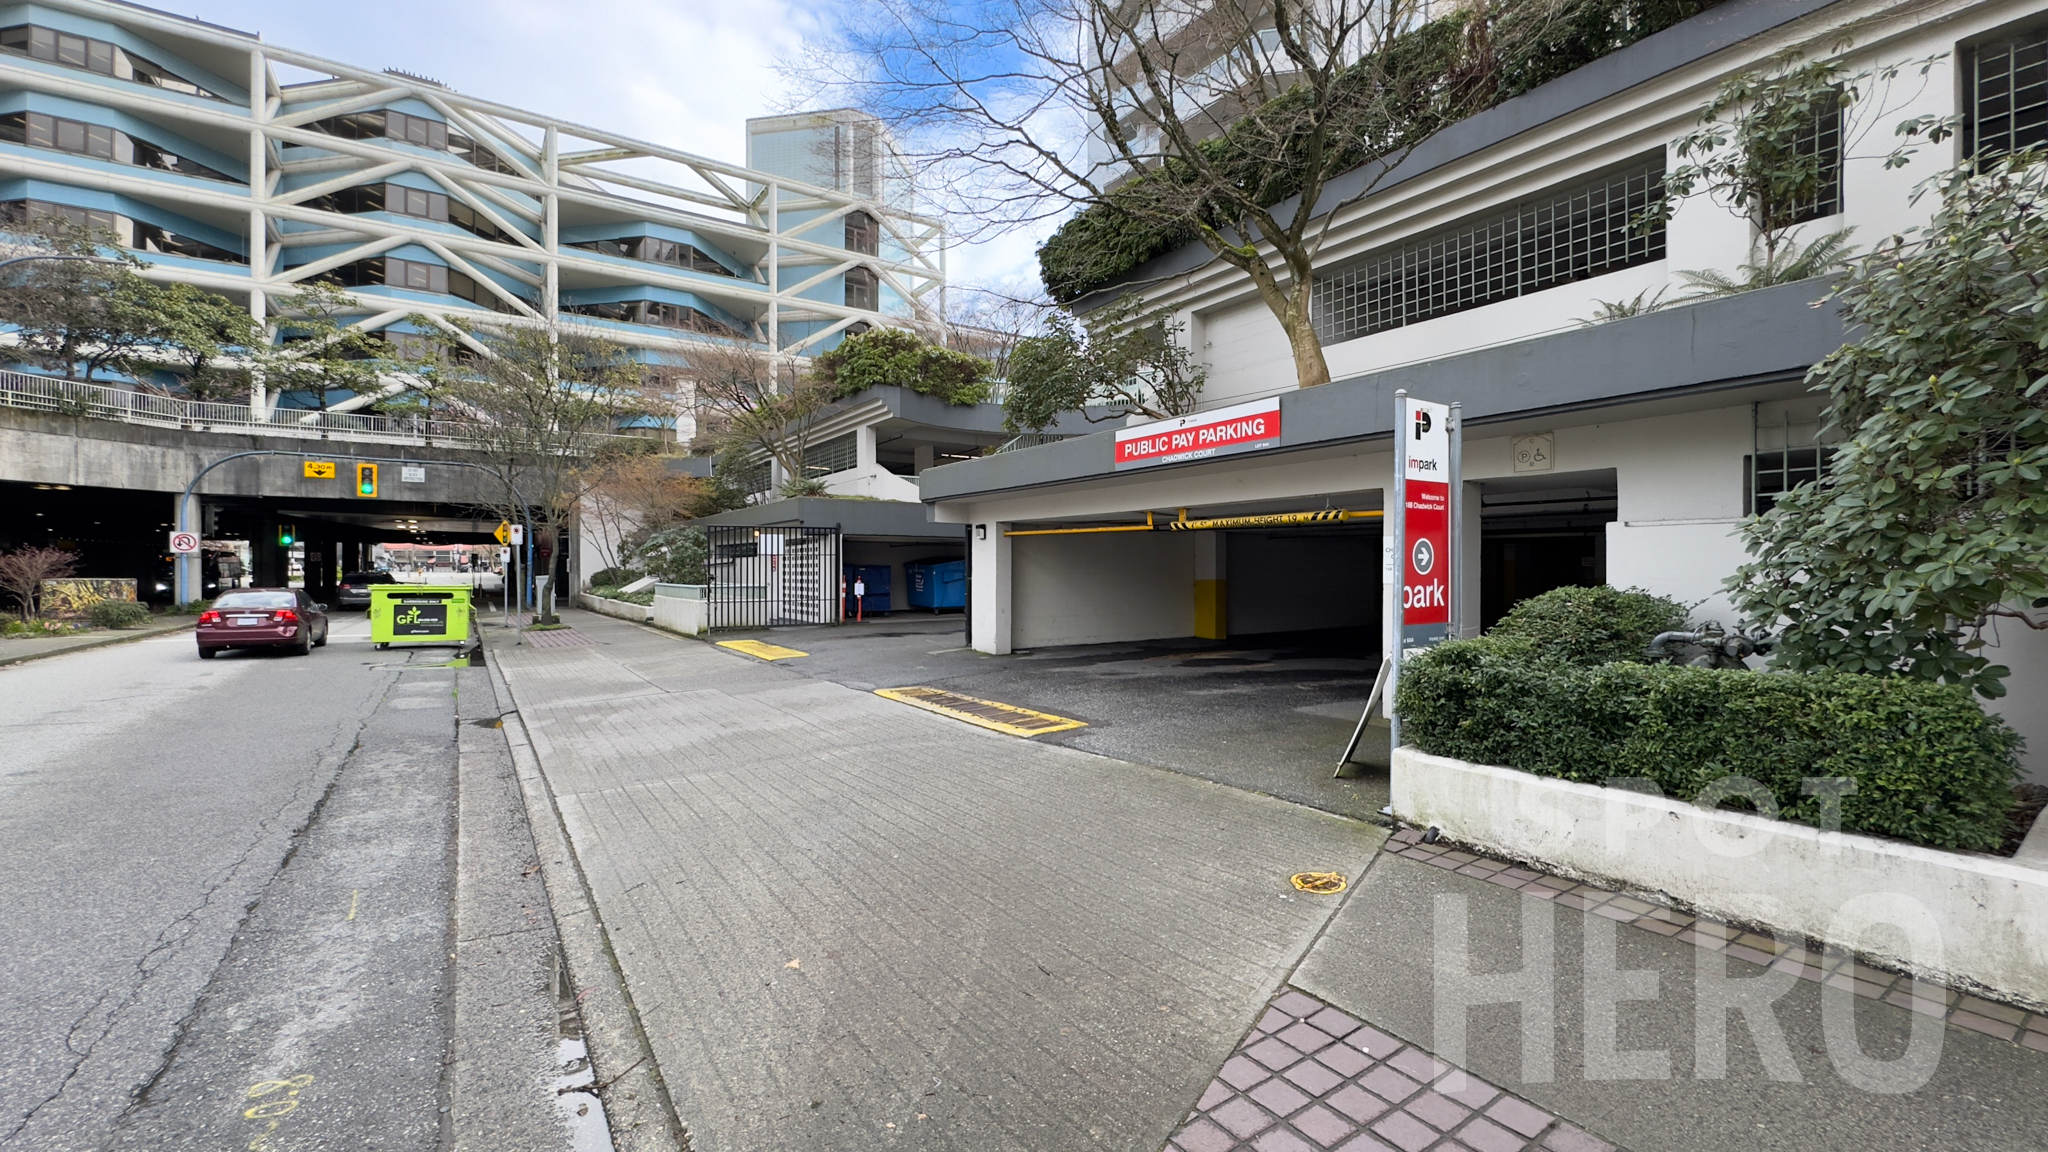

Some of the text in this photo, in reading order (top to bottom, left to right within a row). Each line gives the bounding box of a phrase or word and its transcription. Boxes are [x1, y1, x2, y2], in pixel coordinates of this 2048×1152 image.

[1124, 418, 1265, 457] PUBLIC PAY PARKING
[1161, 448, 1216, 463] CHADWICK COURT
[1521, 453, 1528, 461] P
[307, 462, 325, 470] 4.30
[1408, 455, 1437, 472] impark
[1421, 493, 1439, 501] Welcome
[1413, 502, 1432, 510] Chadwick
[1212, 518, 1251, 528] MAXIMUM
[1252, 515, 1283, 525] HEIGHT
[396, 612, 421, 625] GFL
